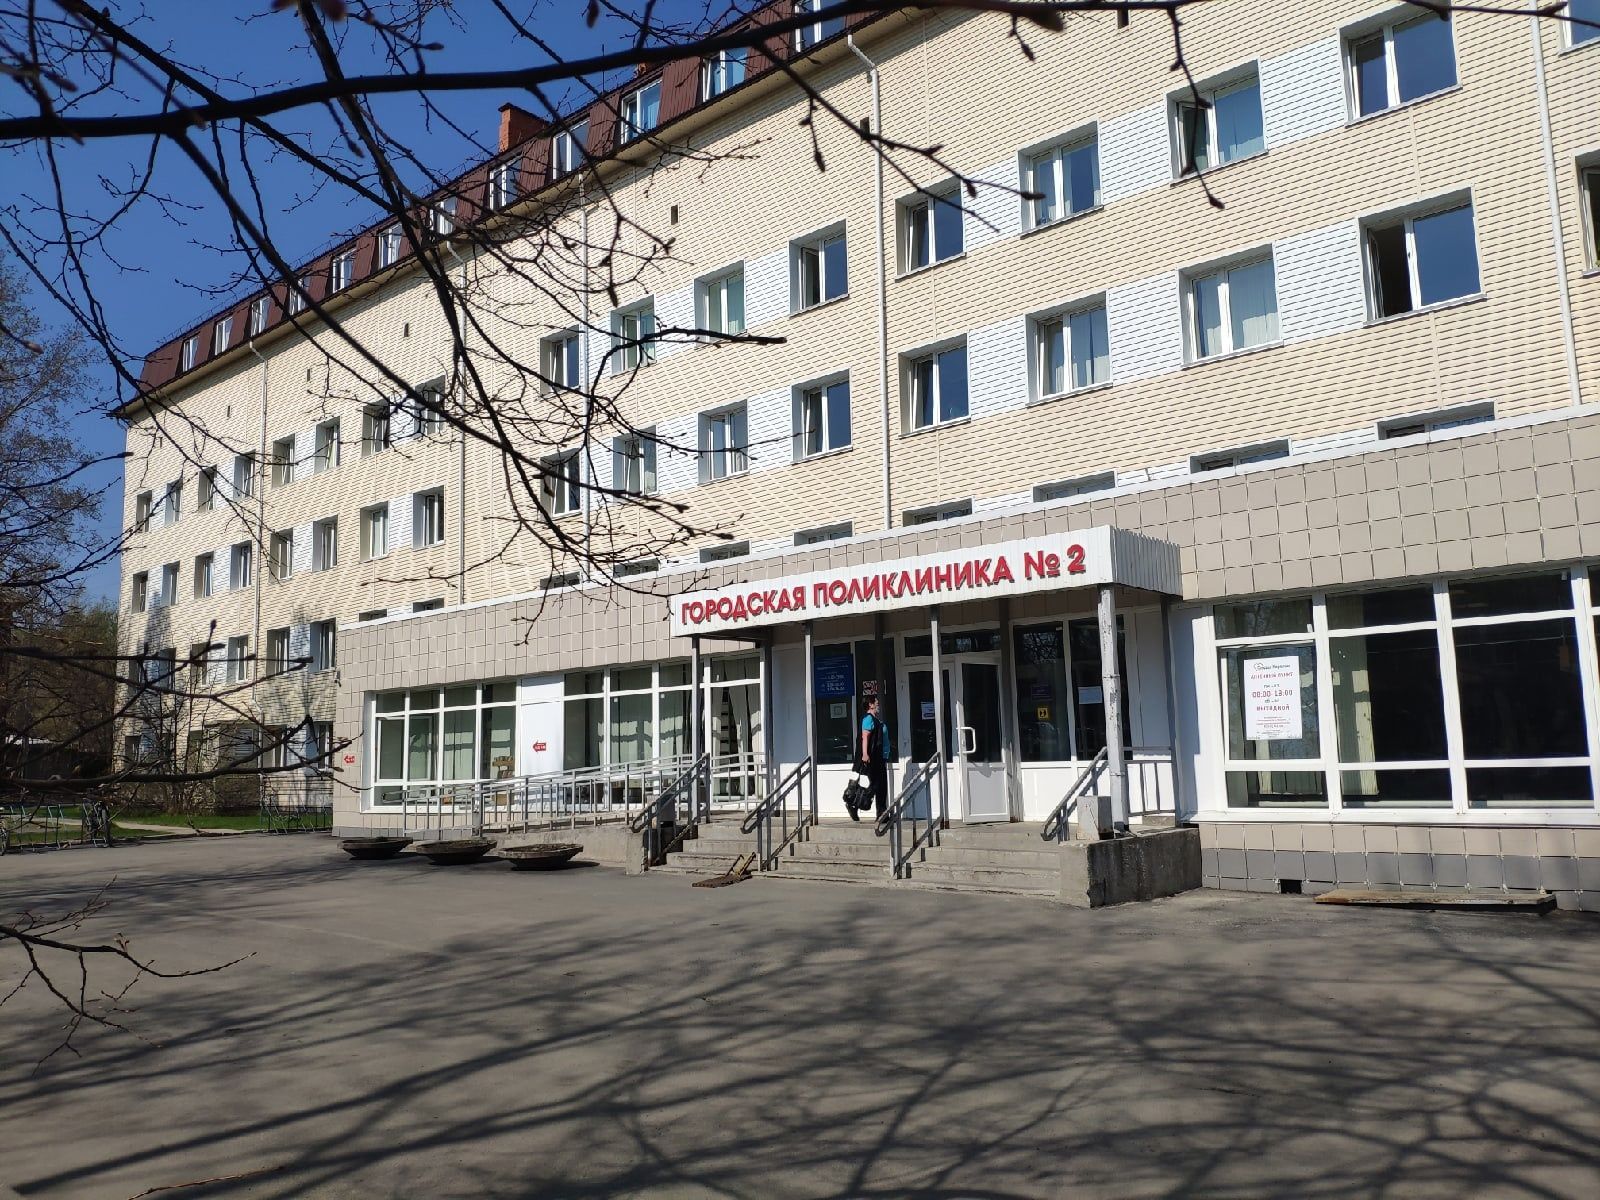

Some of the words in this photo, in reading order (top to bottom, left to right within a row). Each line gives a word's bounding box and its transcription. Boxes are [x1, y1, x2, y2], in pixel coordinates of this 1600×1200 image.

[681, 586, 806, 625] ГОРОДСКАЯ
[813, 556, 1014, 608] ПОЛИКЛИНИКА
[1024, 550, 1060, 581] №
[1067, 544, 1086, 575] 2
